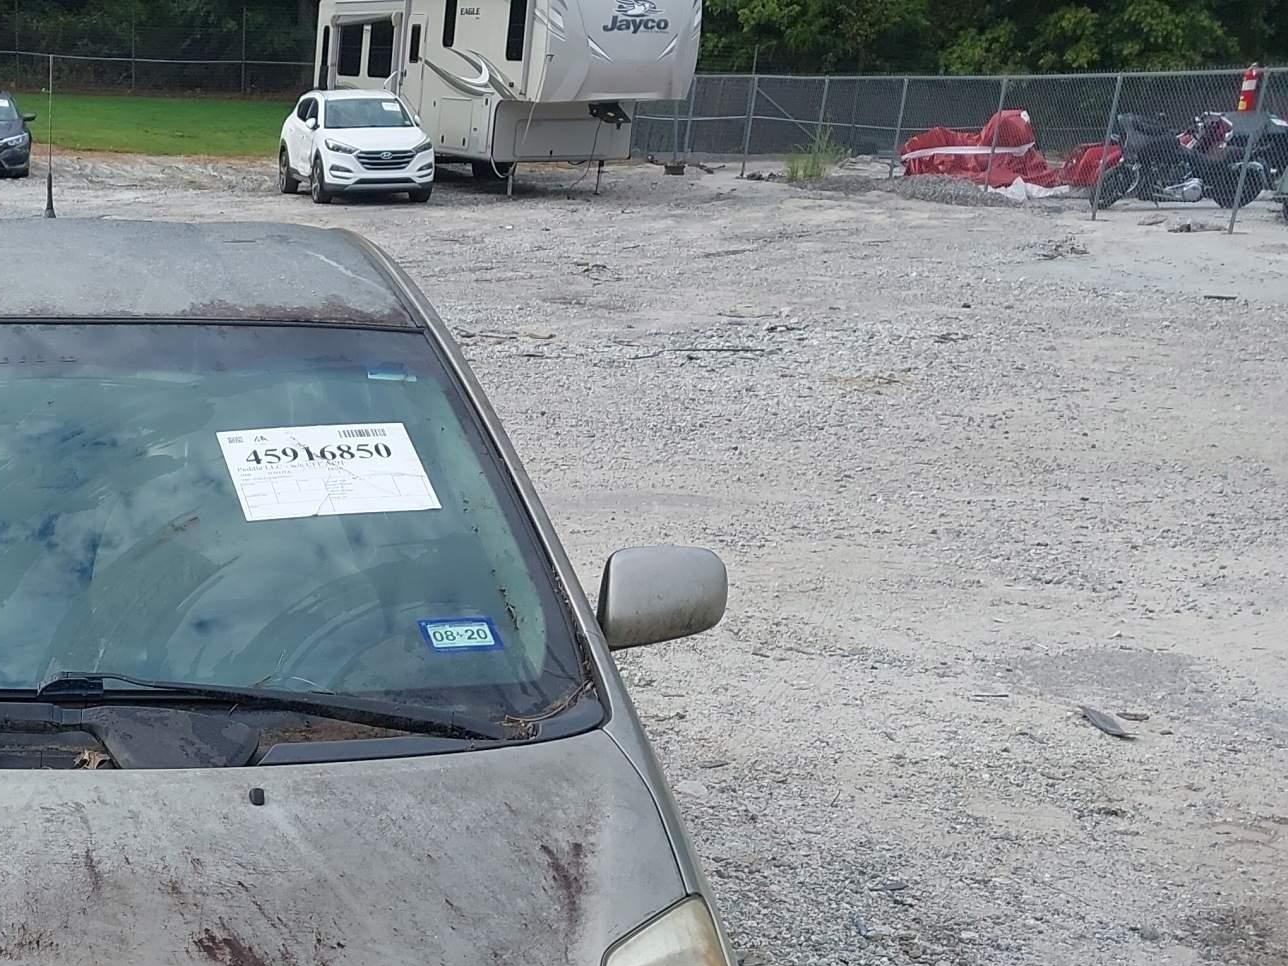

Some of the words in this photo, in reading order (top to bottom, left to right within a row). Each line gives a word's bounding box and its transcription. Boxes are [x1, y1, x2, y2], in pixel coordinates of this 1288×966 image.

[460, 7, 480, 16] EAGLE
[602, 15, 669, 34] Jayco
[246, 442, 392, 465] 45916850
[433, 630, 457, 642] 08
[464, 628, 488, 640] 20
